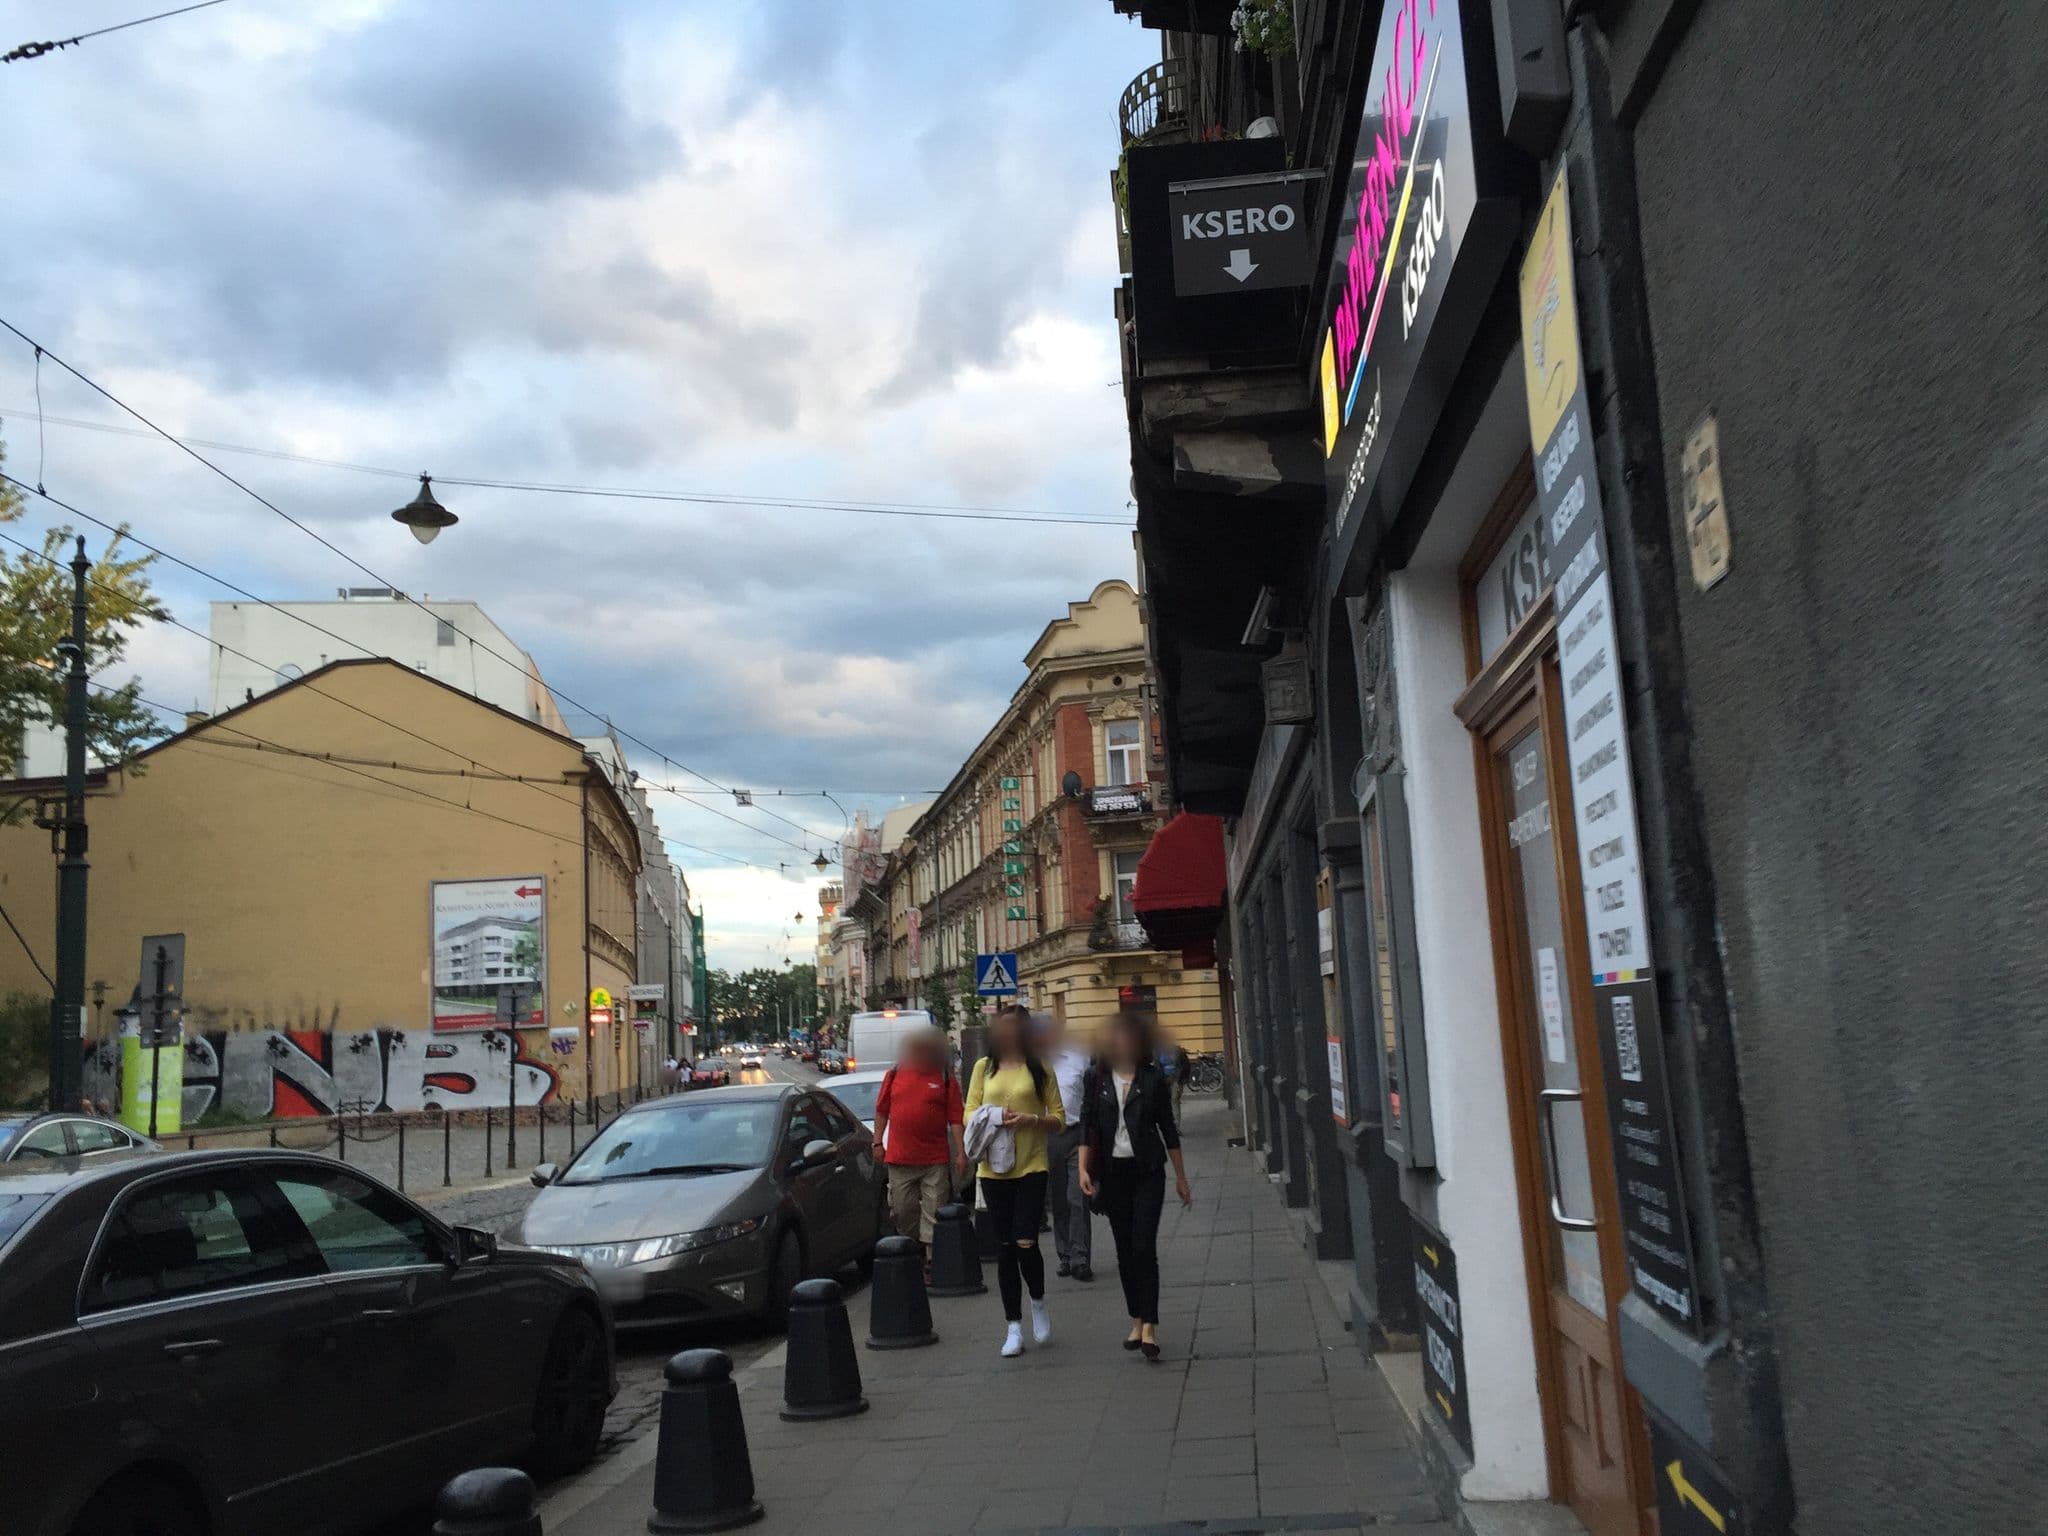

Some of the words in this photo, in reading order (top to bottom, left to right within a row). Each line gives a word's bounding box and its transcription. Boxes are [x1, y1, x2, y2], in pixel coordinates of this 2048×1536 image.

[1182, 204, 1295, 240] KSERO
[1335, 0, 1437, 389] PAPIERNICZ
[1402, 158, 1445, 342] KSERO
